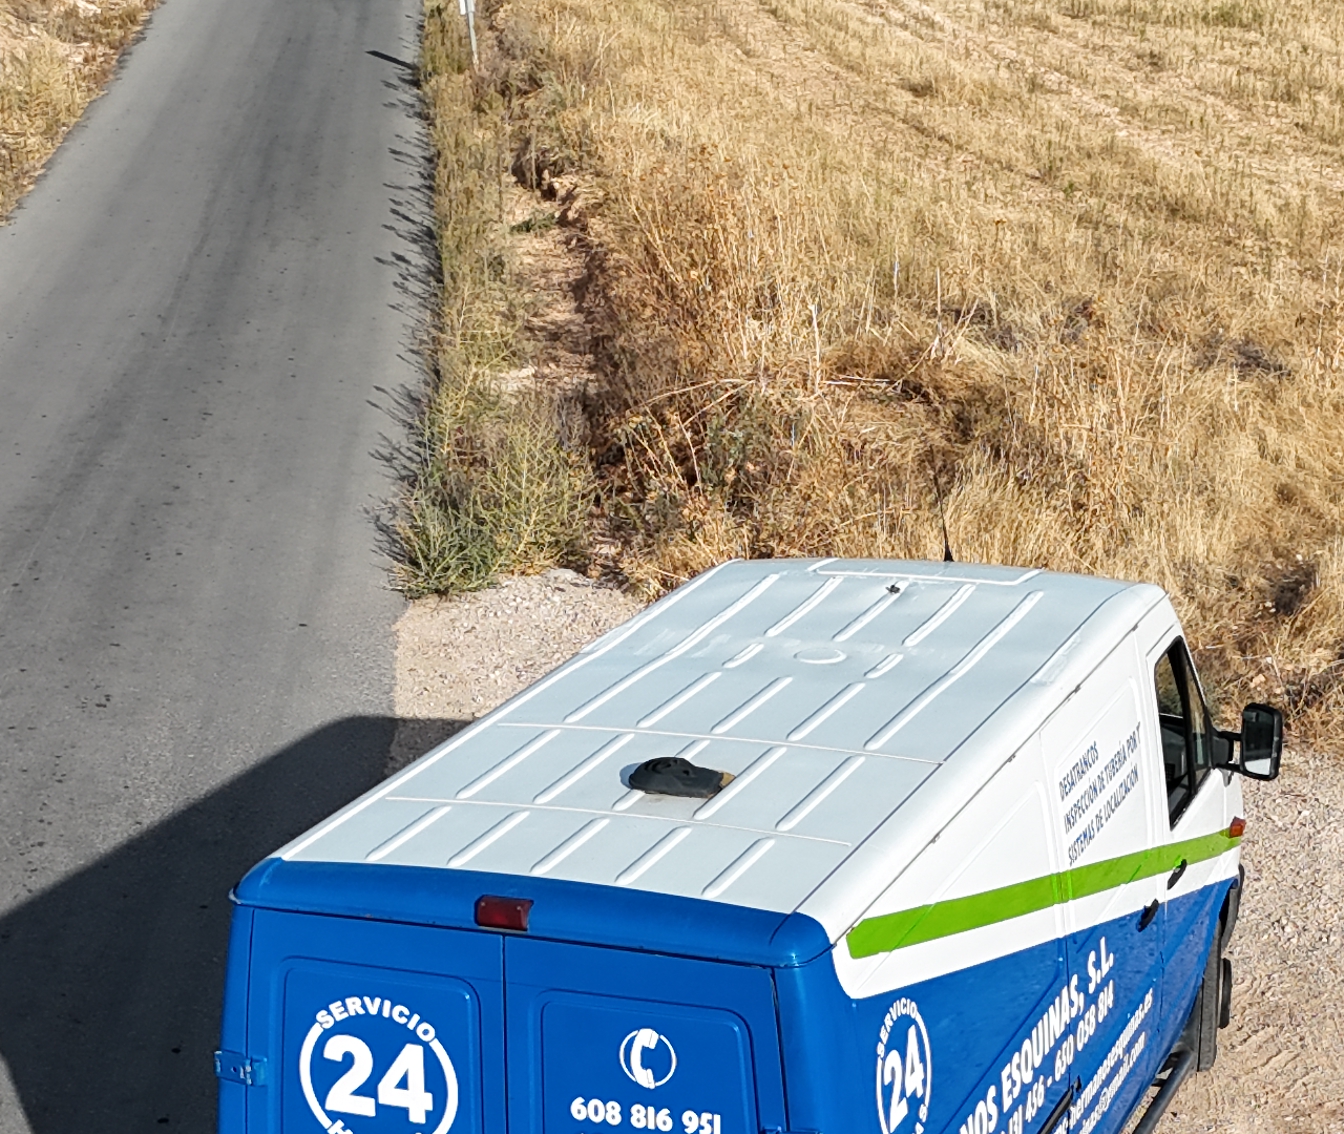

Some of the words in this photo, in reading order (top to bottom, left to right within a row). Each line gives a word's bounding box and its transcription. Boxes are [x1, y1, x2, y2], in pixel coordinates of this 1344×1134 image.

[1058, 740, 1099, 802] DESATRANCOS
[1064, 777, 1098, 835] INSPECCIÓN
[1097, 770, 1106, 794] DE
[1126, 730, 1137, 758] POR
[1068, 819, 1095, 867] SISTEMAS
[1095, 808, 1104, 834] DE
[1104, 761, 1139, 823] LOCALIZACIÓN
[316, 995, 436, 1043] SERVICIO
[877, 997, 918, 1058] SERVICIO
[1000, 973, 1085, 1113] ESQUINAS,
[1087, 936, 1114, 994] S.L.
[1025, 1074, 1044, 1123] 456
[1054, 1033, 1074, 1082] 650
[1076, 1003, 1095, 1051] 058
[1097, 979, 1114, 1024] 814
[323, 1034, 433, 1125] 24
[570, 1096, 623, 1126] 608
[630, 1104, 674, 1132] 816
[883, 1025, 924, 1133] 24
